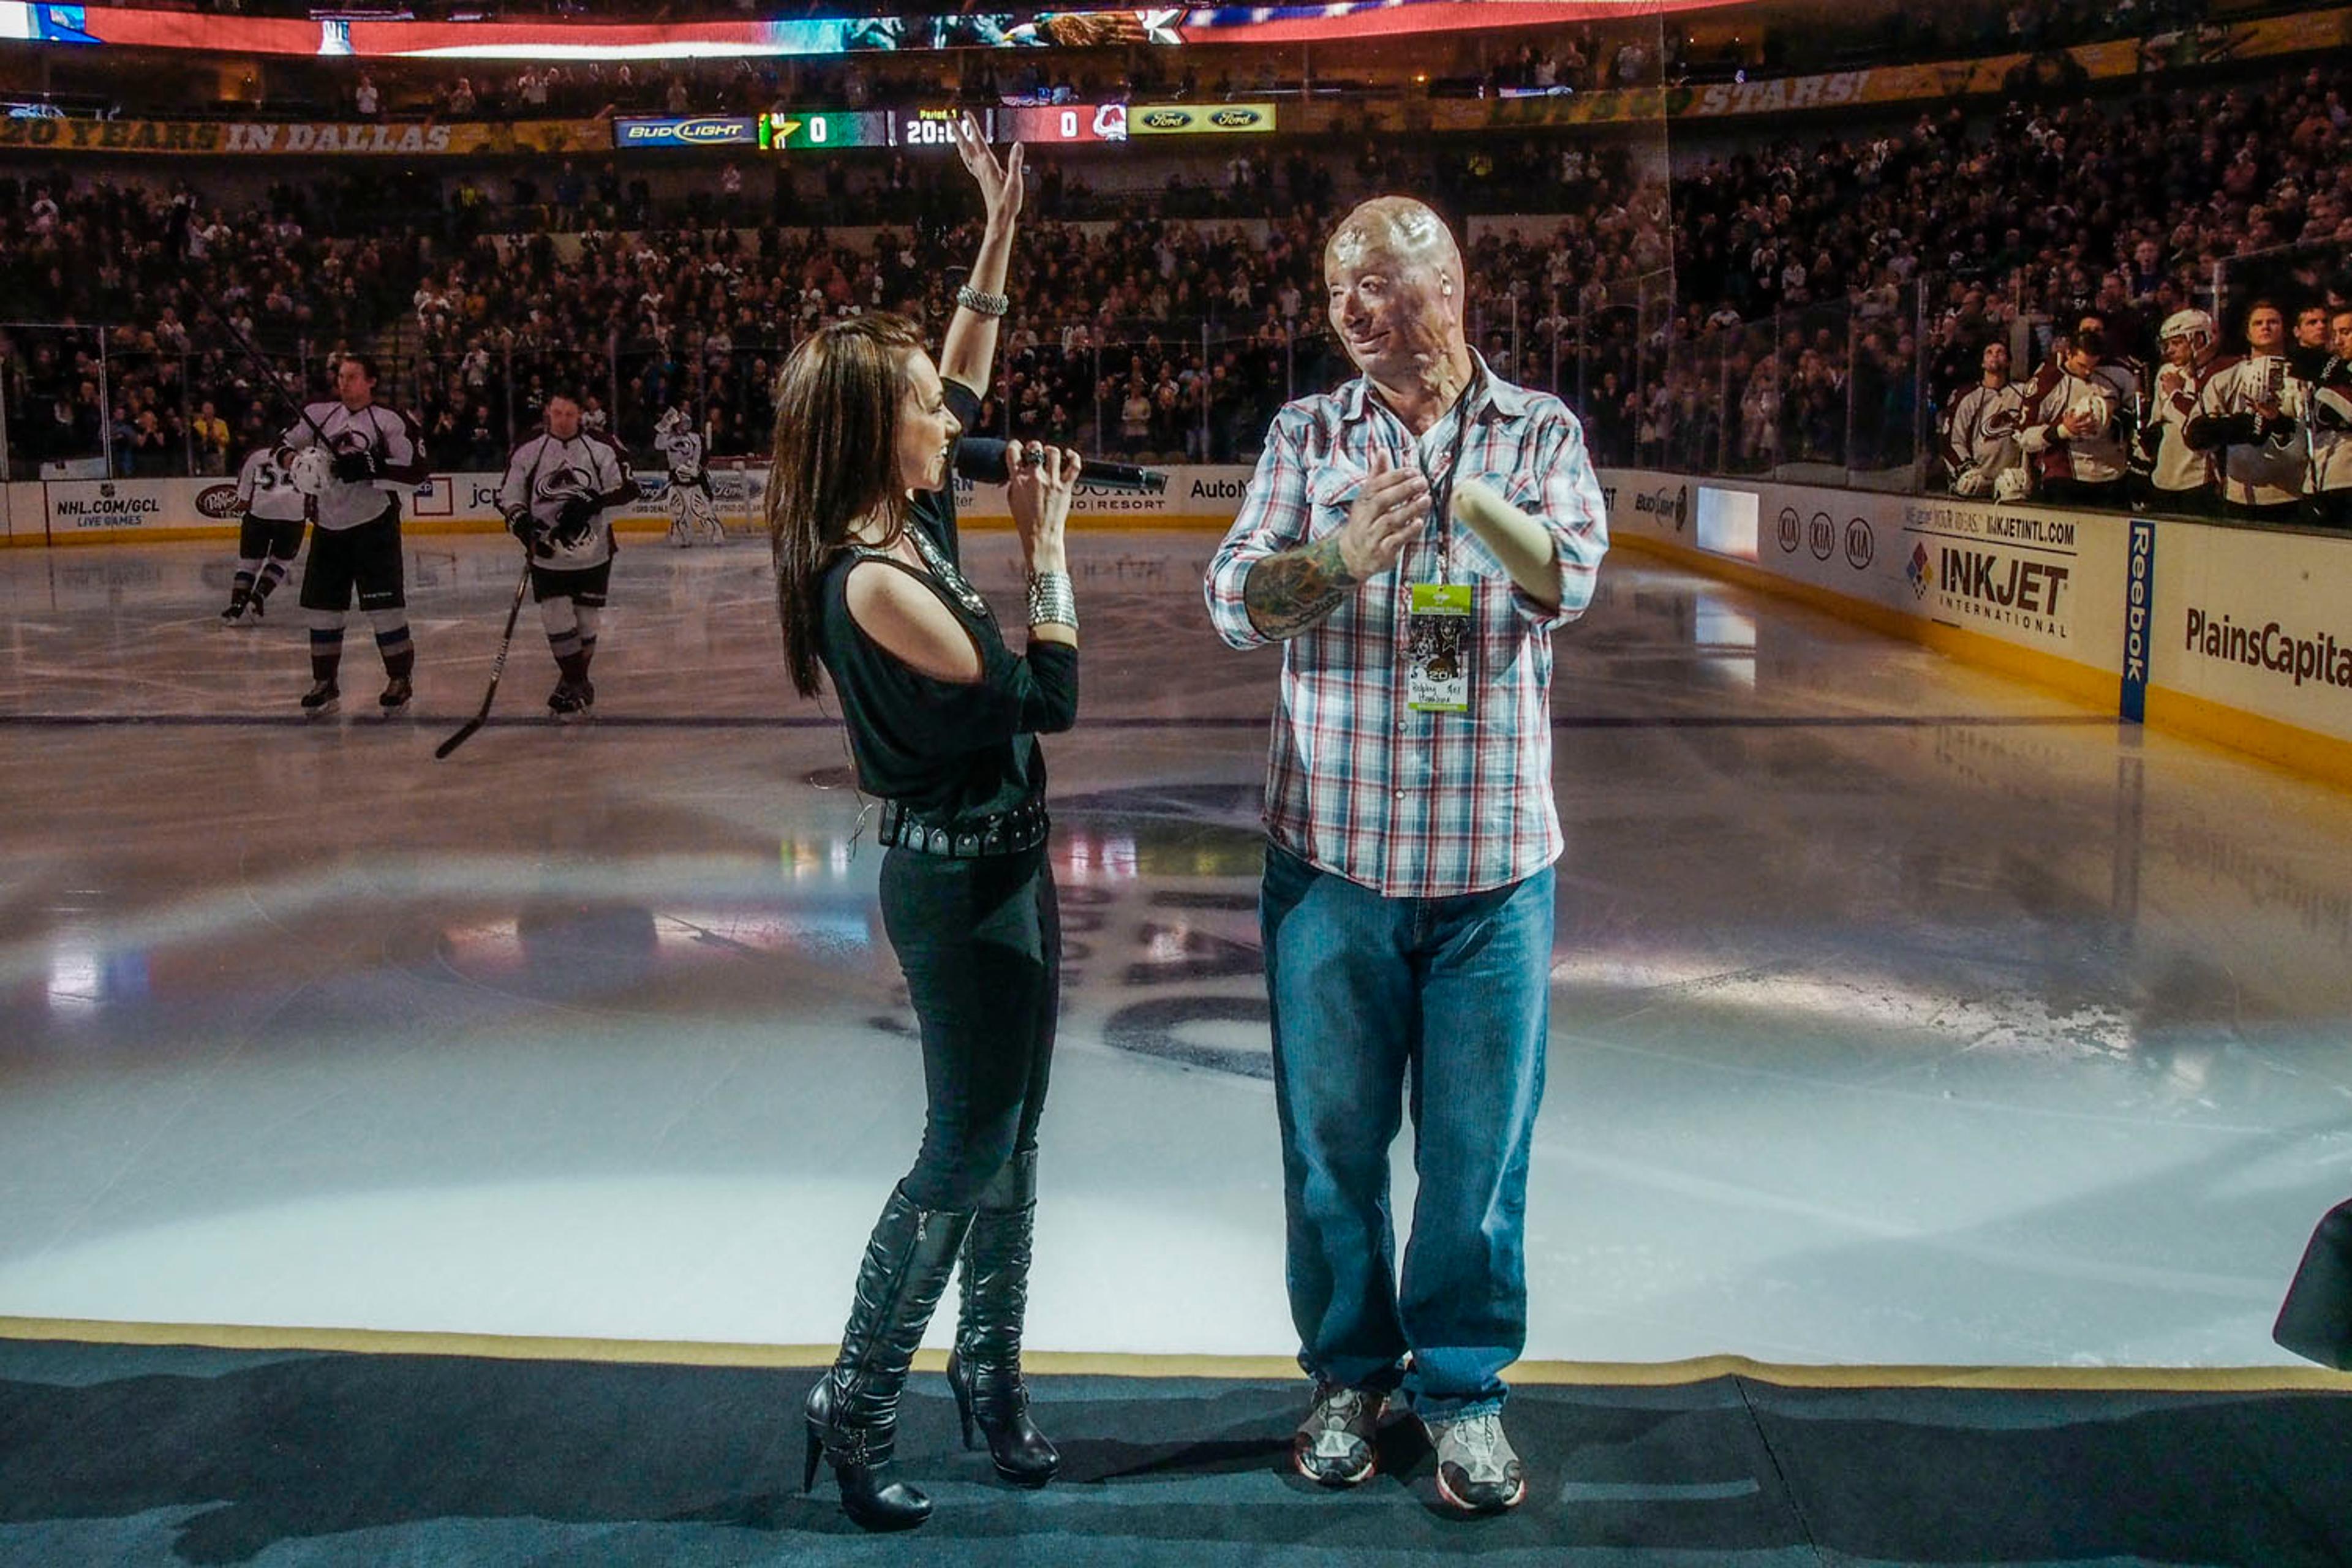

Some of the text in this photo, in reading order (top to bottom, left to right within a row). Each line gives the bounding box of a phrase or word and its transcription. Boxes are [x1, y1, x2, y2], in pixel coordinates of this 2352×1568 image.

[1699, 71, 1869, 115] STARS!
[628, 124, 744, 138] BUD LIGHT
[810, 116, 827, 143] 0
[1061, 111, 1077, 137] 0
[1151, 112, 1183, 127] Ford
[1218, 111, 1251, 125] Ford
[72, 121, 219, 149] YEARS
[225, 124, 277, 151] IN
[285, 124, 450, 152] DALLAS
[1191, 480, 1247, 497] AutoN
[58, 499, 160, 515] NHL.COM/GCL
[1097, 500, 1166, 510] RESORT
[78, 515, 141, 527] LIVE GAMES
[1781, 518, 1868, 559] KIA KIA KIA
[1940, 547, 2069, 616] INKJET
[2127, 526, 2149, 683] Reebok
[1939, 597, 2067, 639] INTERNATIONAL
